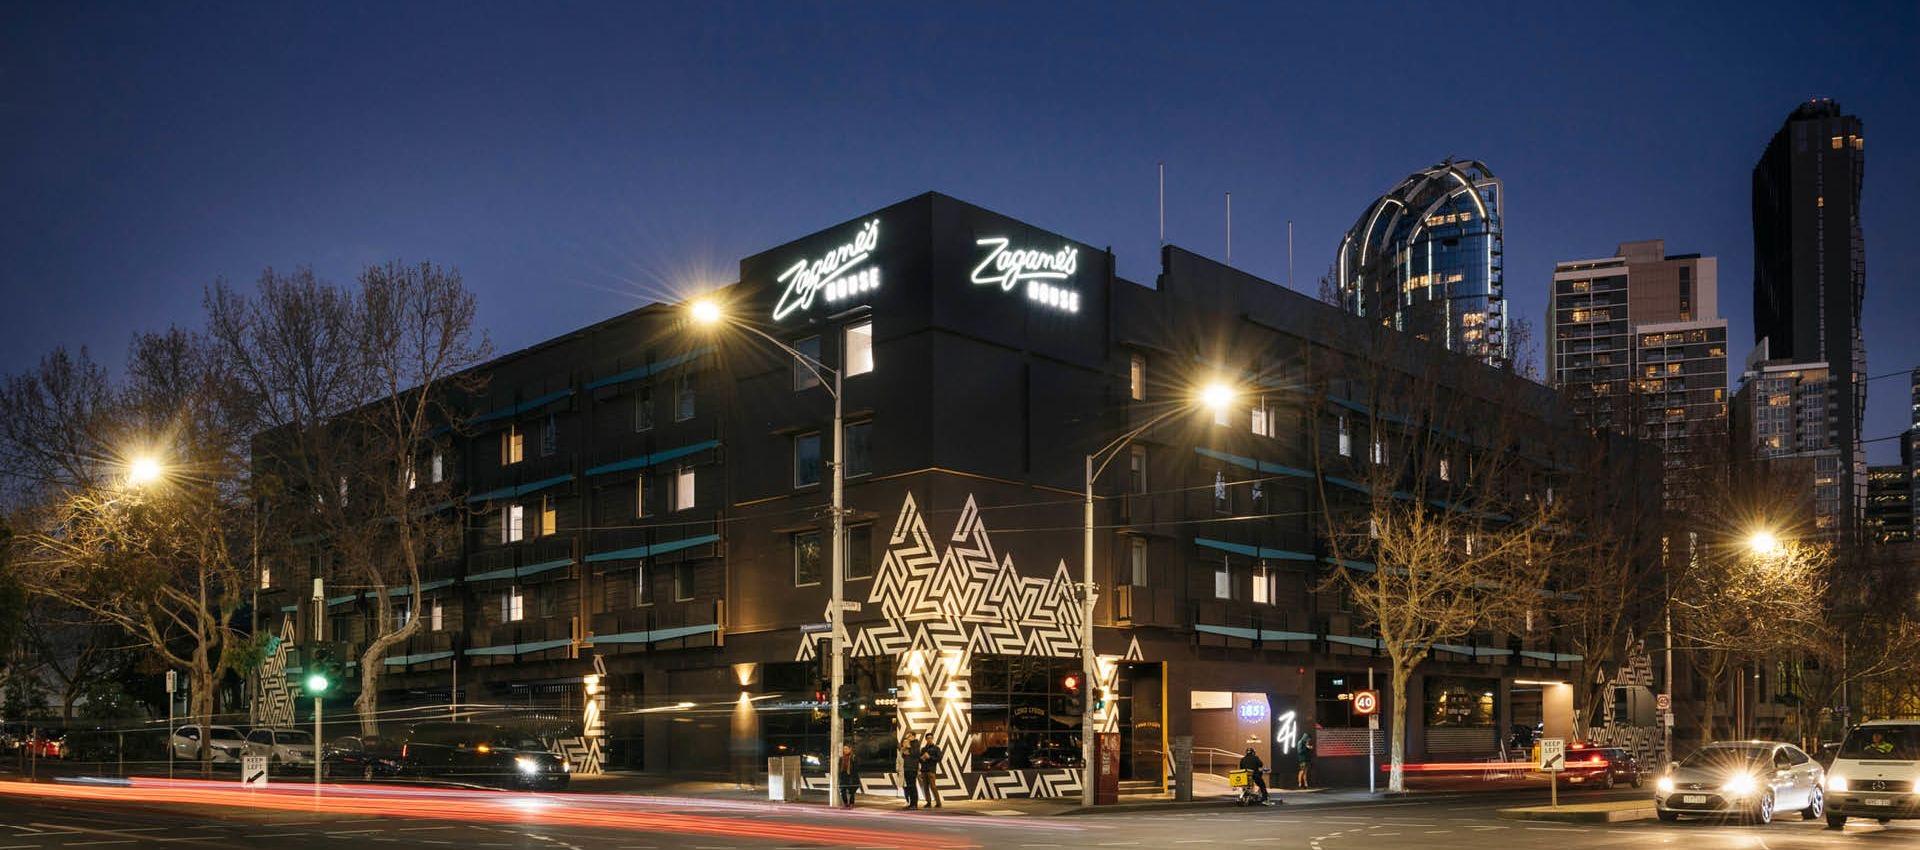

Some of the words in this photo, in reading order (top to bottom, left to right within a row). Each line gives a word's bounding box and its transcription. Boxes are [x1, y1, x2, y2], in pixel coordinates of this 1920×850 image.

[772, 218, 880, 321] Zagame's
[971, 237, 1079, 291] Zagame's
[825, 267, 880, 302] HOUSE
[1027, 281, 1079, 313] HOUSE
[1241, 704, 1265, 717] 1851
[1358, 697, 1372, 707] 40
